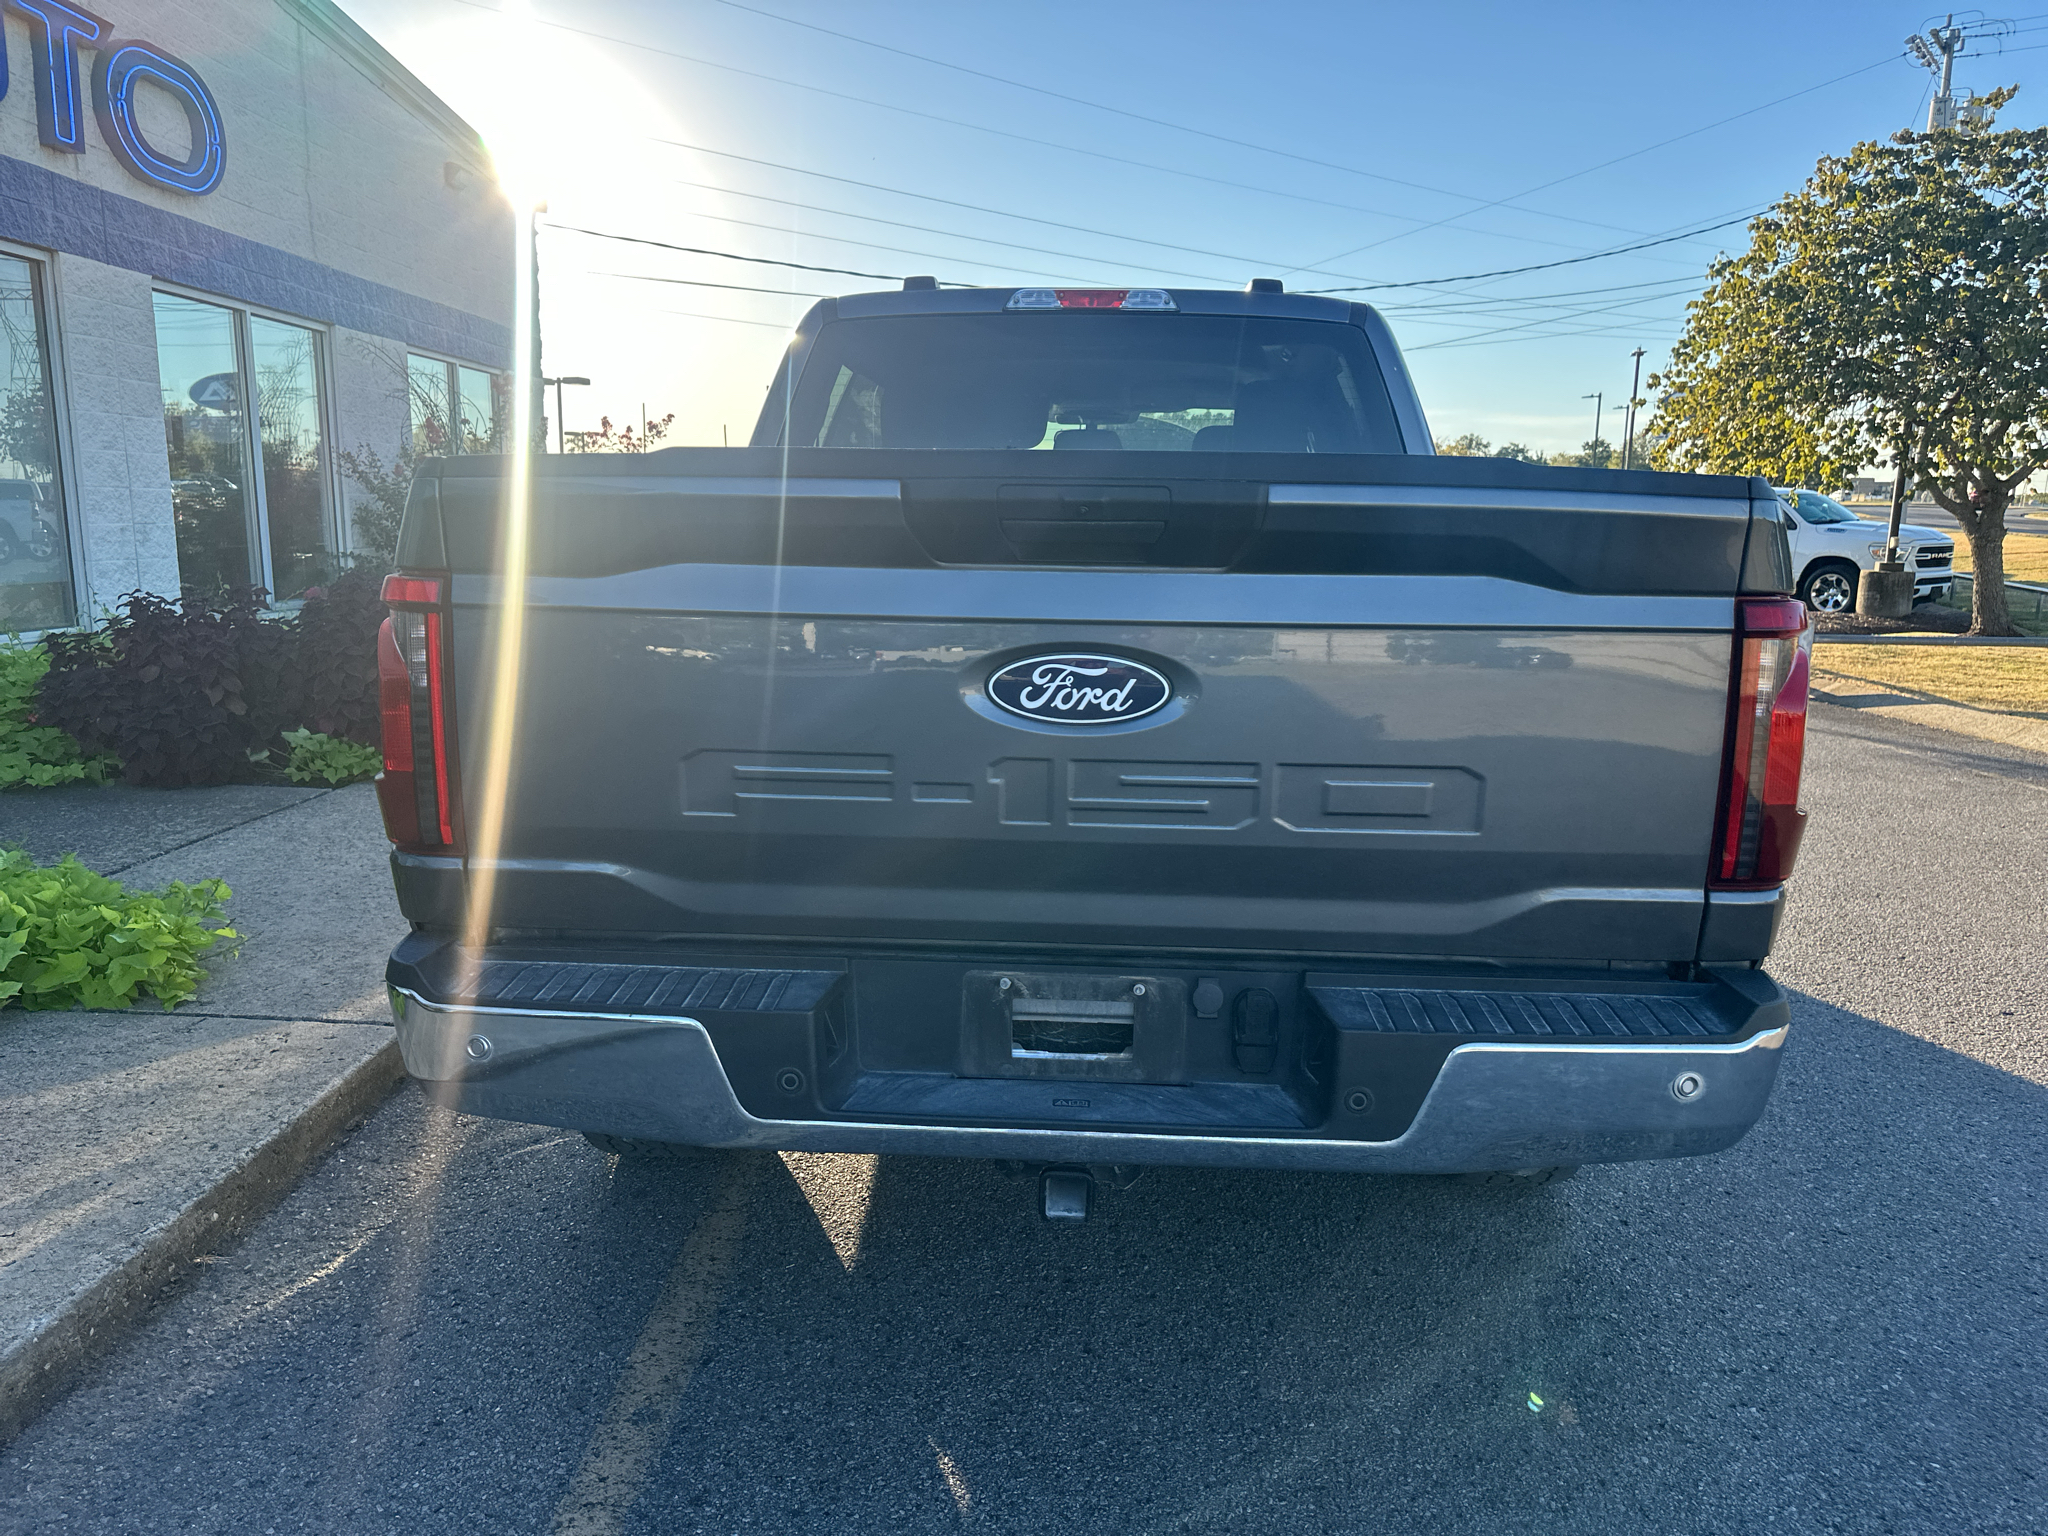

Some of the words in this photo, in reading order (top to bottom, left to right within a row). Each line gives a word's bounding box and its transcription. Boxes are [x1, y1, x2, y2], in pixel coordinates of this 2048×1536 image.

[0, 0, 227, 196] TO
[1019, 663, 1137, 712] Ford
[679, 748, 1487, 836] F-150
